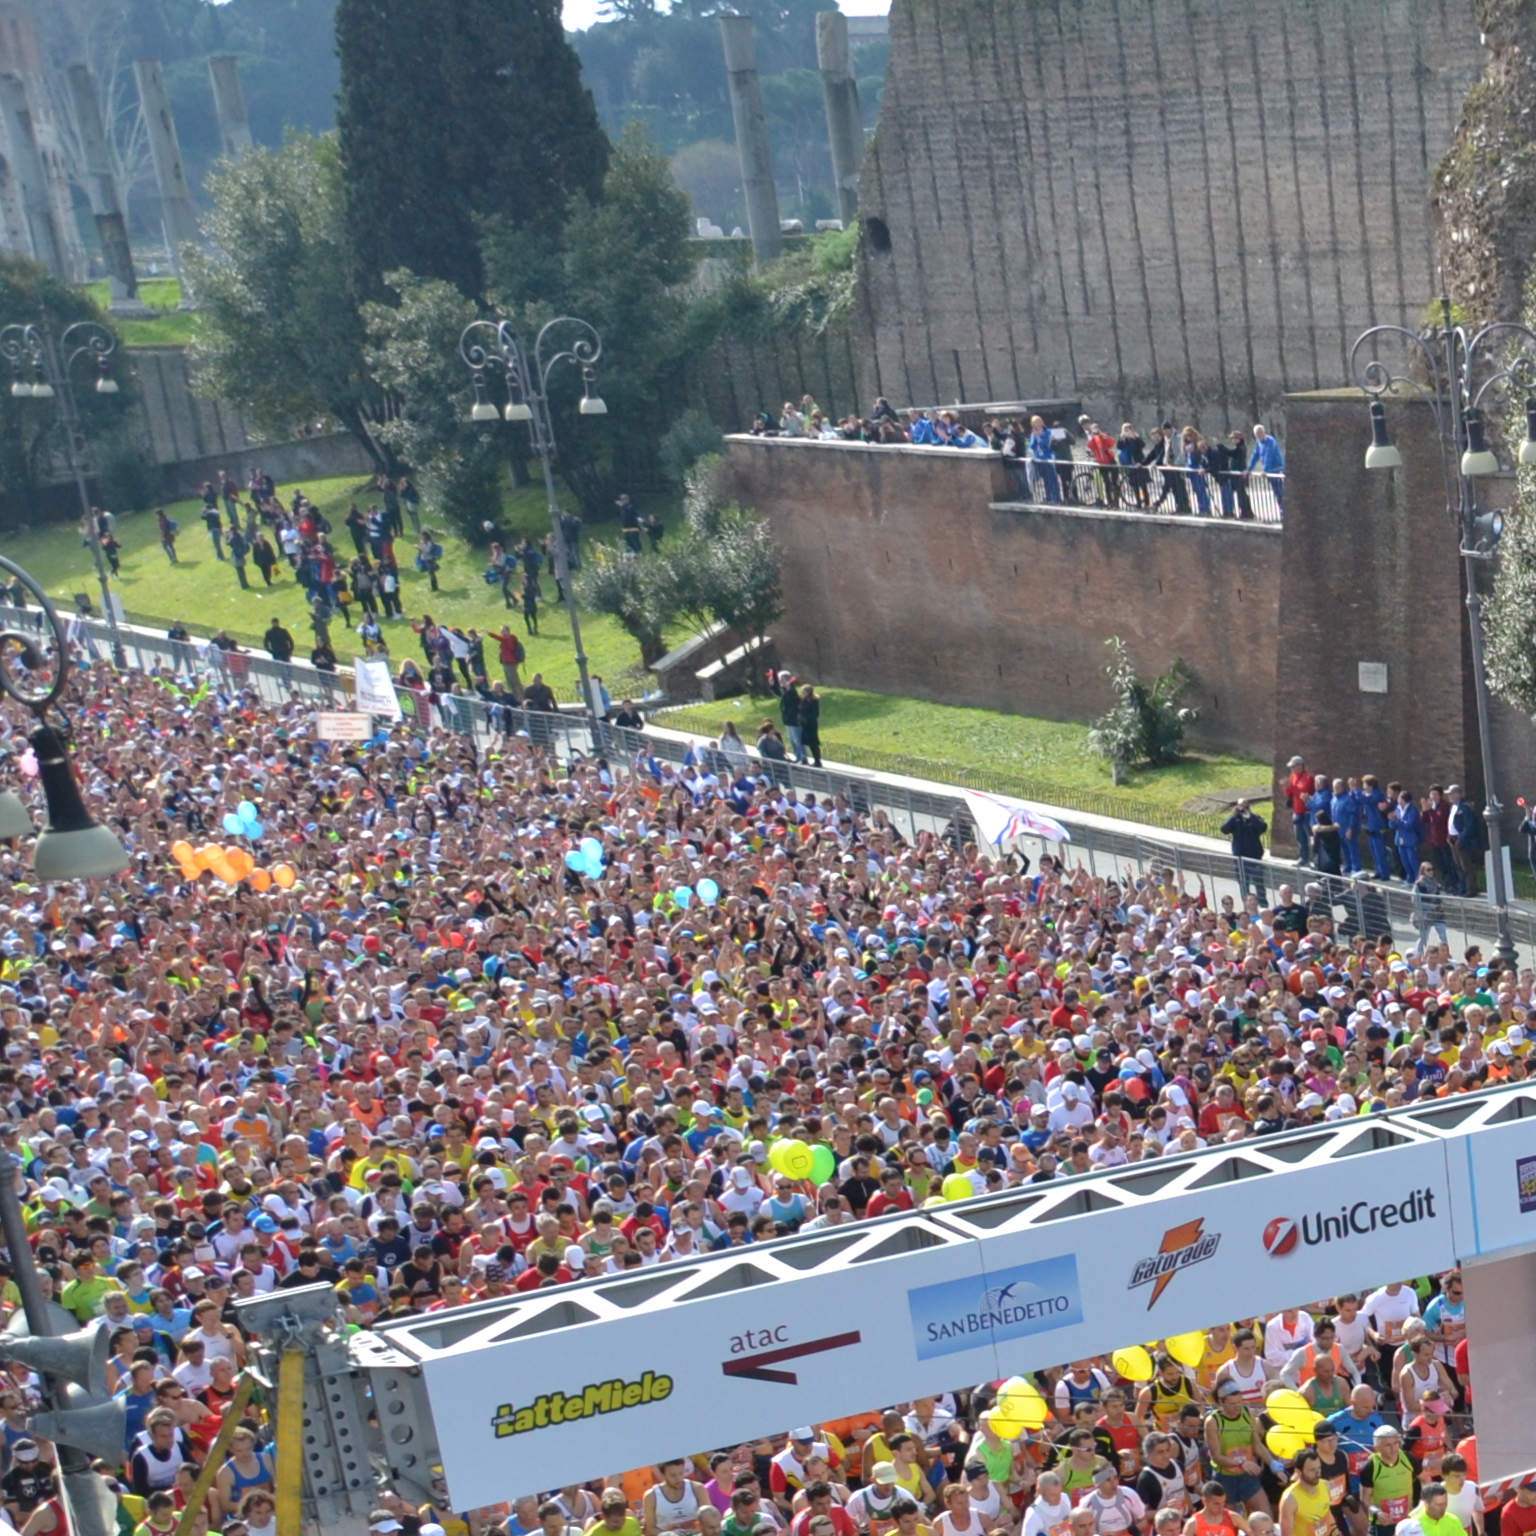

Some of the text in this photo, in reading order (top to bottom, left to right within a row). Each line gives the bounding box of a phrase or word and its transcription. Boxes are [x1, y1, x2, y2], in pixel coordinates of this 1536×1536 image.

[1302, 1187, 1436, 1246] UniCredit
[1133, 1233, 1220, 1286] Gatorade
[729, 1323, 789, 1354] atac
[495, 1371, 673, 1438] LatteMiele
